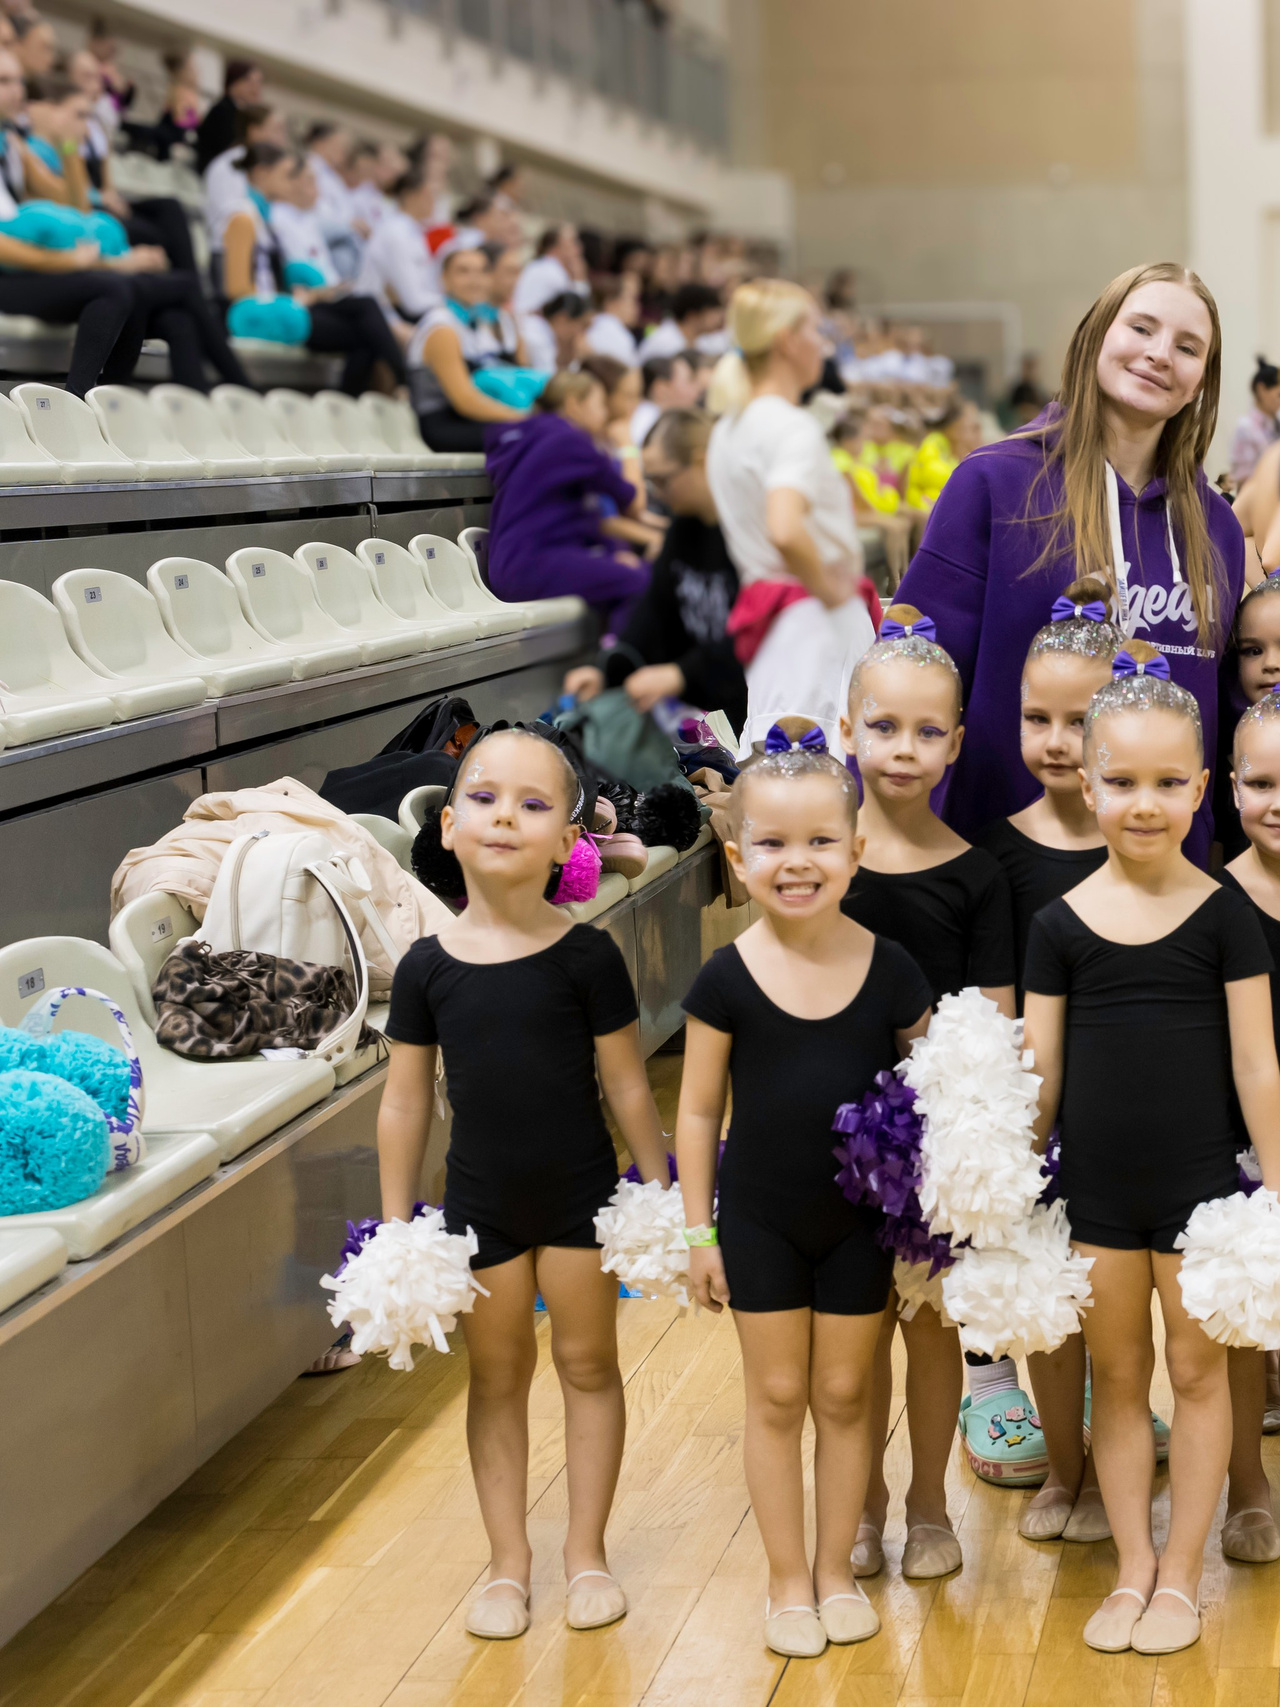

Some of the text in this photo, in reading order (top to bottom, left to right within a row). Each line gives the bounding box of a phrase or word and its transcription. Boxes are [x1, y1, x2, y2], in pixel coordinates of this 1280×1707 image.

[89, 591, 97, 600] 23
[158, 923, 166, 935] 19
[25, 976, 36, 990] 18
